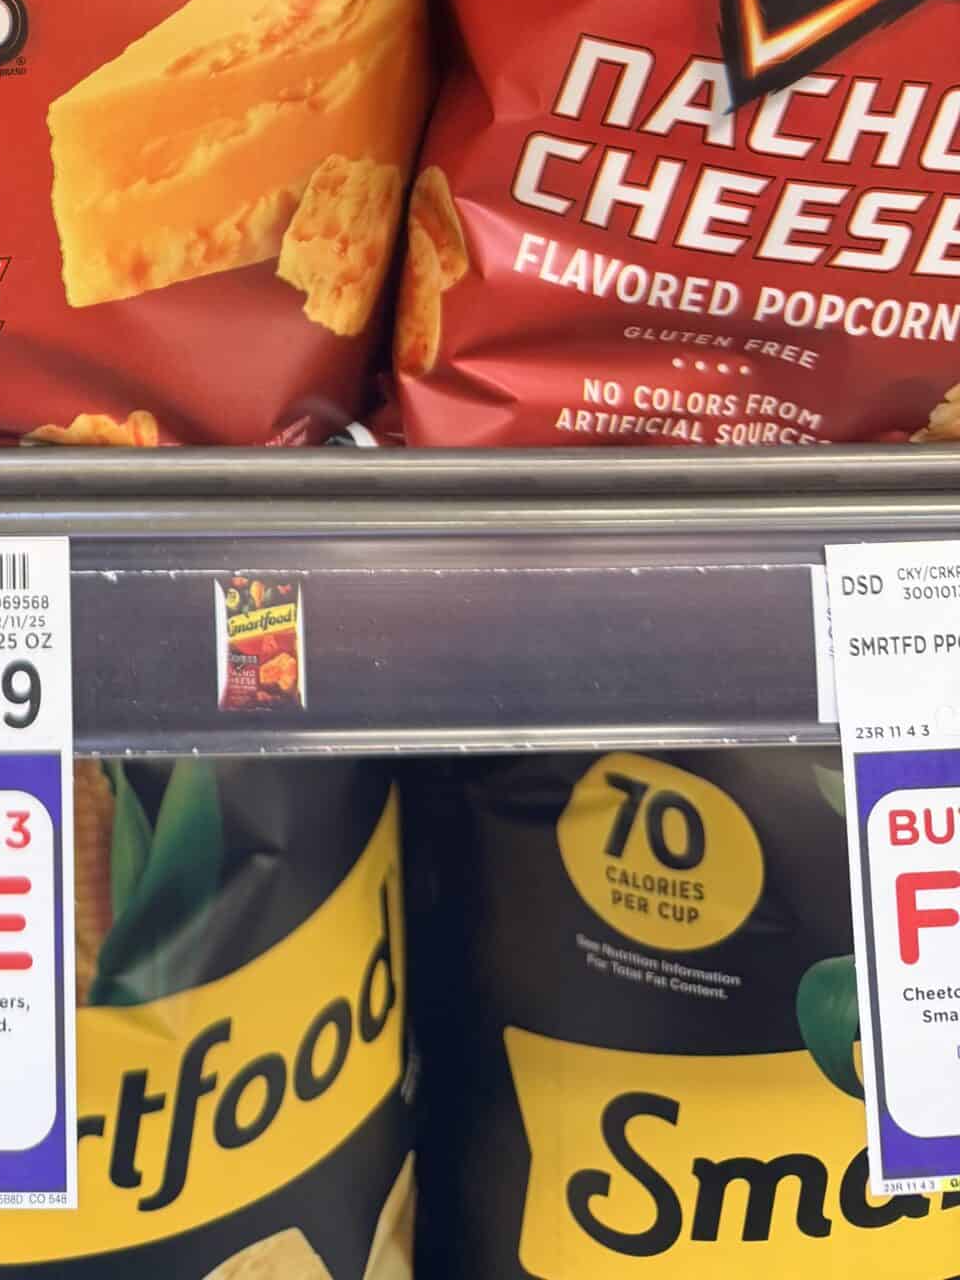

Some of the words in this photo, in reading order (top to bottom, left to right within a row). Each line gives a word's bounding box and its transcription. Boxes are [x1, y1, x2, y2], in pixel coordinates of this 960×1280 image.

[513, 231, 740, 318] FLAVORED
[753, 286, 960, 343] POPCORN
[623, 325, 732, 348] GLUTEN
[744, 338, 819, 370] FREE
[583, 378, 621, 406] NO
[633, 385, 738, 416] COLORS
[745, 393, 821, 430] FROM
[555, 408, 703, 443] ARTIFICIAL
[715, 422, 833, 445] SOURC
[841, 575, 883, 596] DSD
[903, 586, 960, 600] 300101
[25, 633, 53, 649] OZ
[849, 635, 926, 656] SMRTFD
[934, 634, 960, 654] PP
[855, 726, 884, 739] 23R
[890, 725, 901, 737] 11
[906, 724, 916, 737] 4
[921, 724, 930, 737] 3
[4, 810, 32, 850] 3
[602, 773, 705, 871] 70
[888, 806, 960, 847] BU
[605, 866, 705, 901] CALORIES
[611, 890, 648, 913] PER
[658, 901, 700, 924] CUP
[29, 1193, 46, 1204] CO
